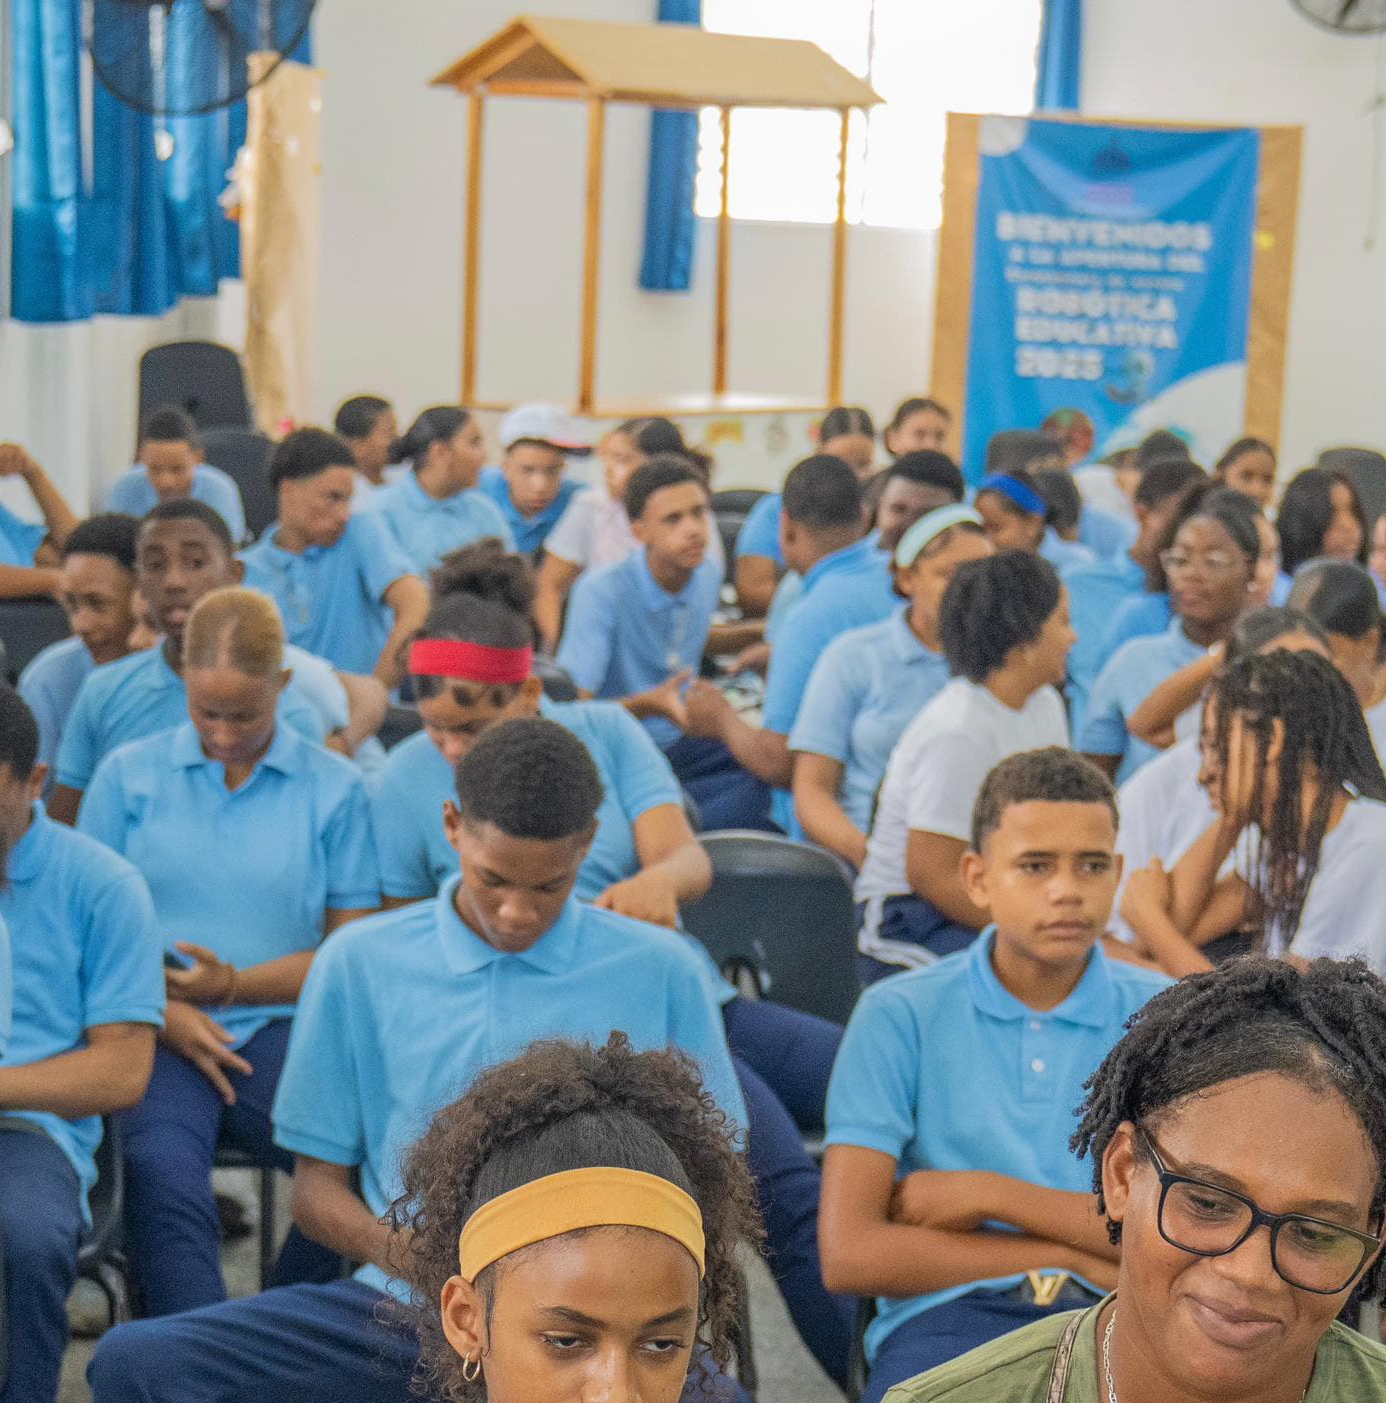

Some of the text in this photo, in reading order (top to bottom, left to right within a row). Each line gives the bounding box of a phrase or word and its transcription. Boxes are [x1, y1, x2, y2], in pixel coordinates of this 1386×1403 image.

[997, 212, 1212, 251] BIENVENIDOS
[1016, 316, 1178, 349] EDUCATIVA
[1016, 345, 1103, 381] 2025
